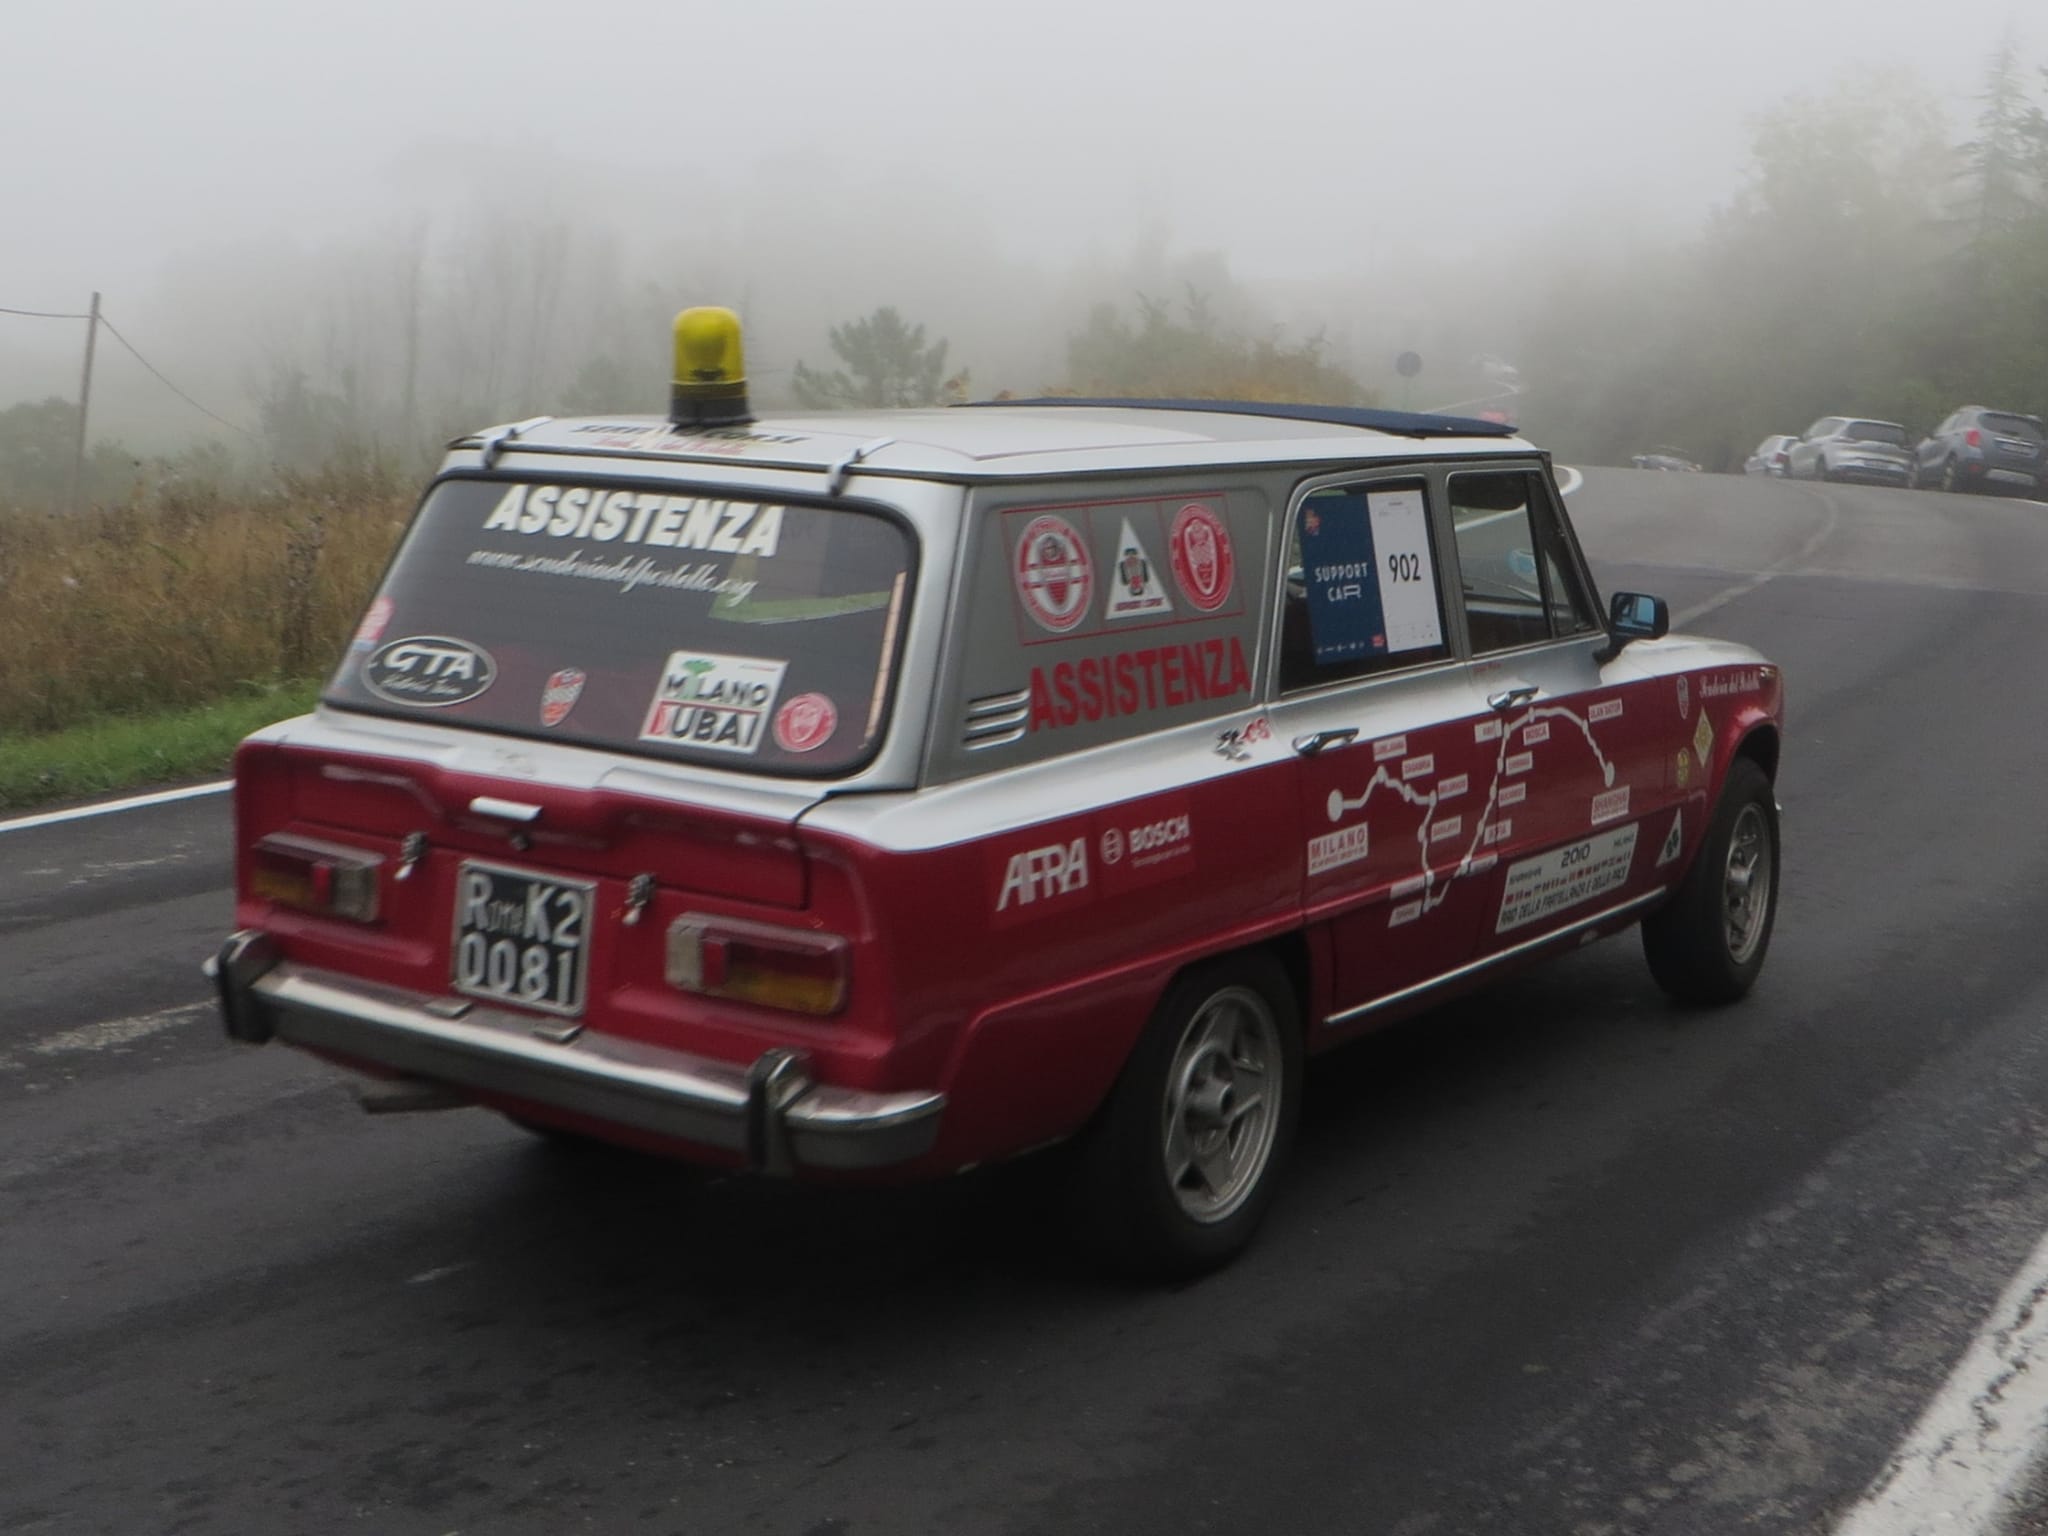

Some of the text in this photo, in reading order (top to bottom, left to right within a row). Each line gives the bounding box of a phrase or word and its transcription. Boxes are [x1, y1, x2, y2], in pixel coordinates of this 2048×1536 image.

[483, 484, 786, 557] ASSISTENZA
[1314, 562, 1368, 583] SUPPORT
[1388, 553, 1421, 583] 902
[384, 643, 475, 680] GTA
[1030, 636, 1253, 733] ASSISTENZA
[1129, 815, 1189, 854] BOSCH
[1311, 827, 1365, 859] MILANO
[1561, 843, 1591, 868] 2010
[457, 931, 573, 1006] 0081
